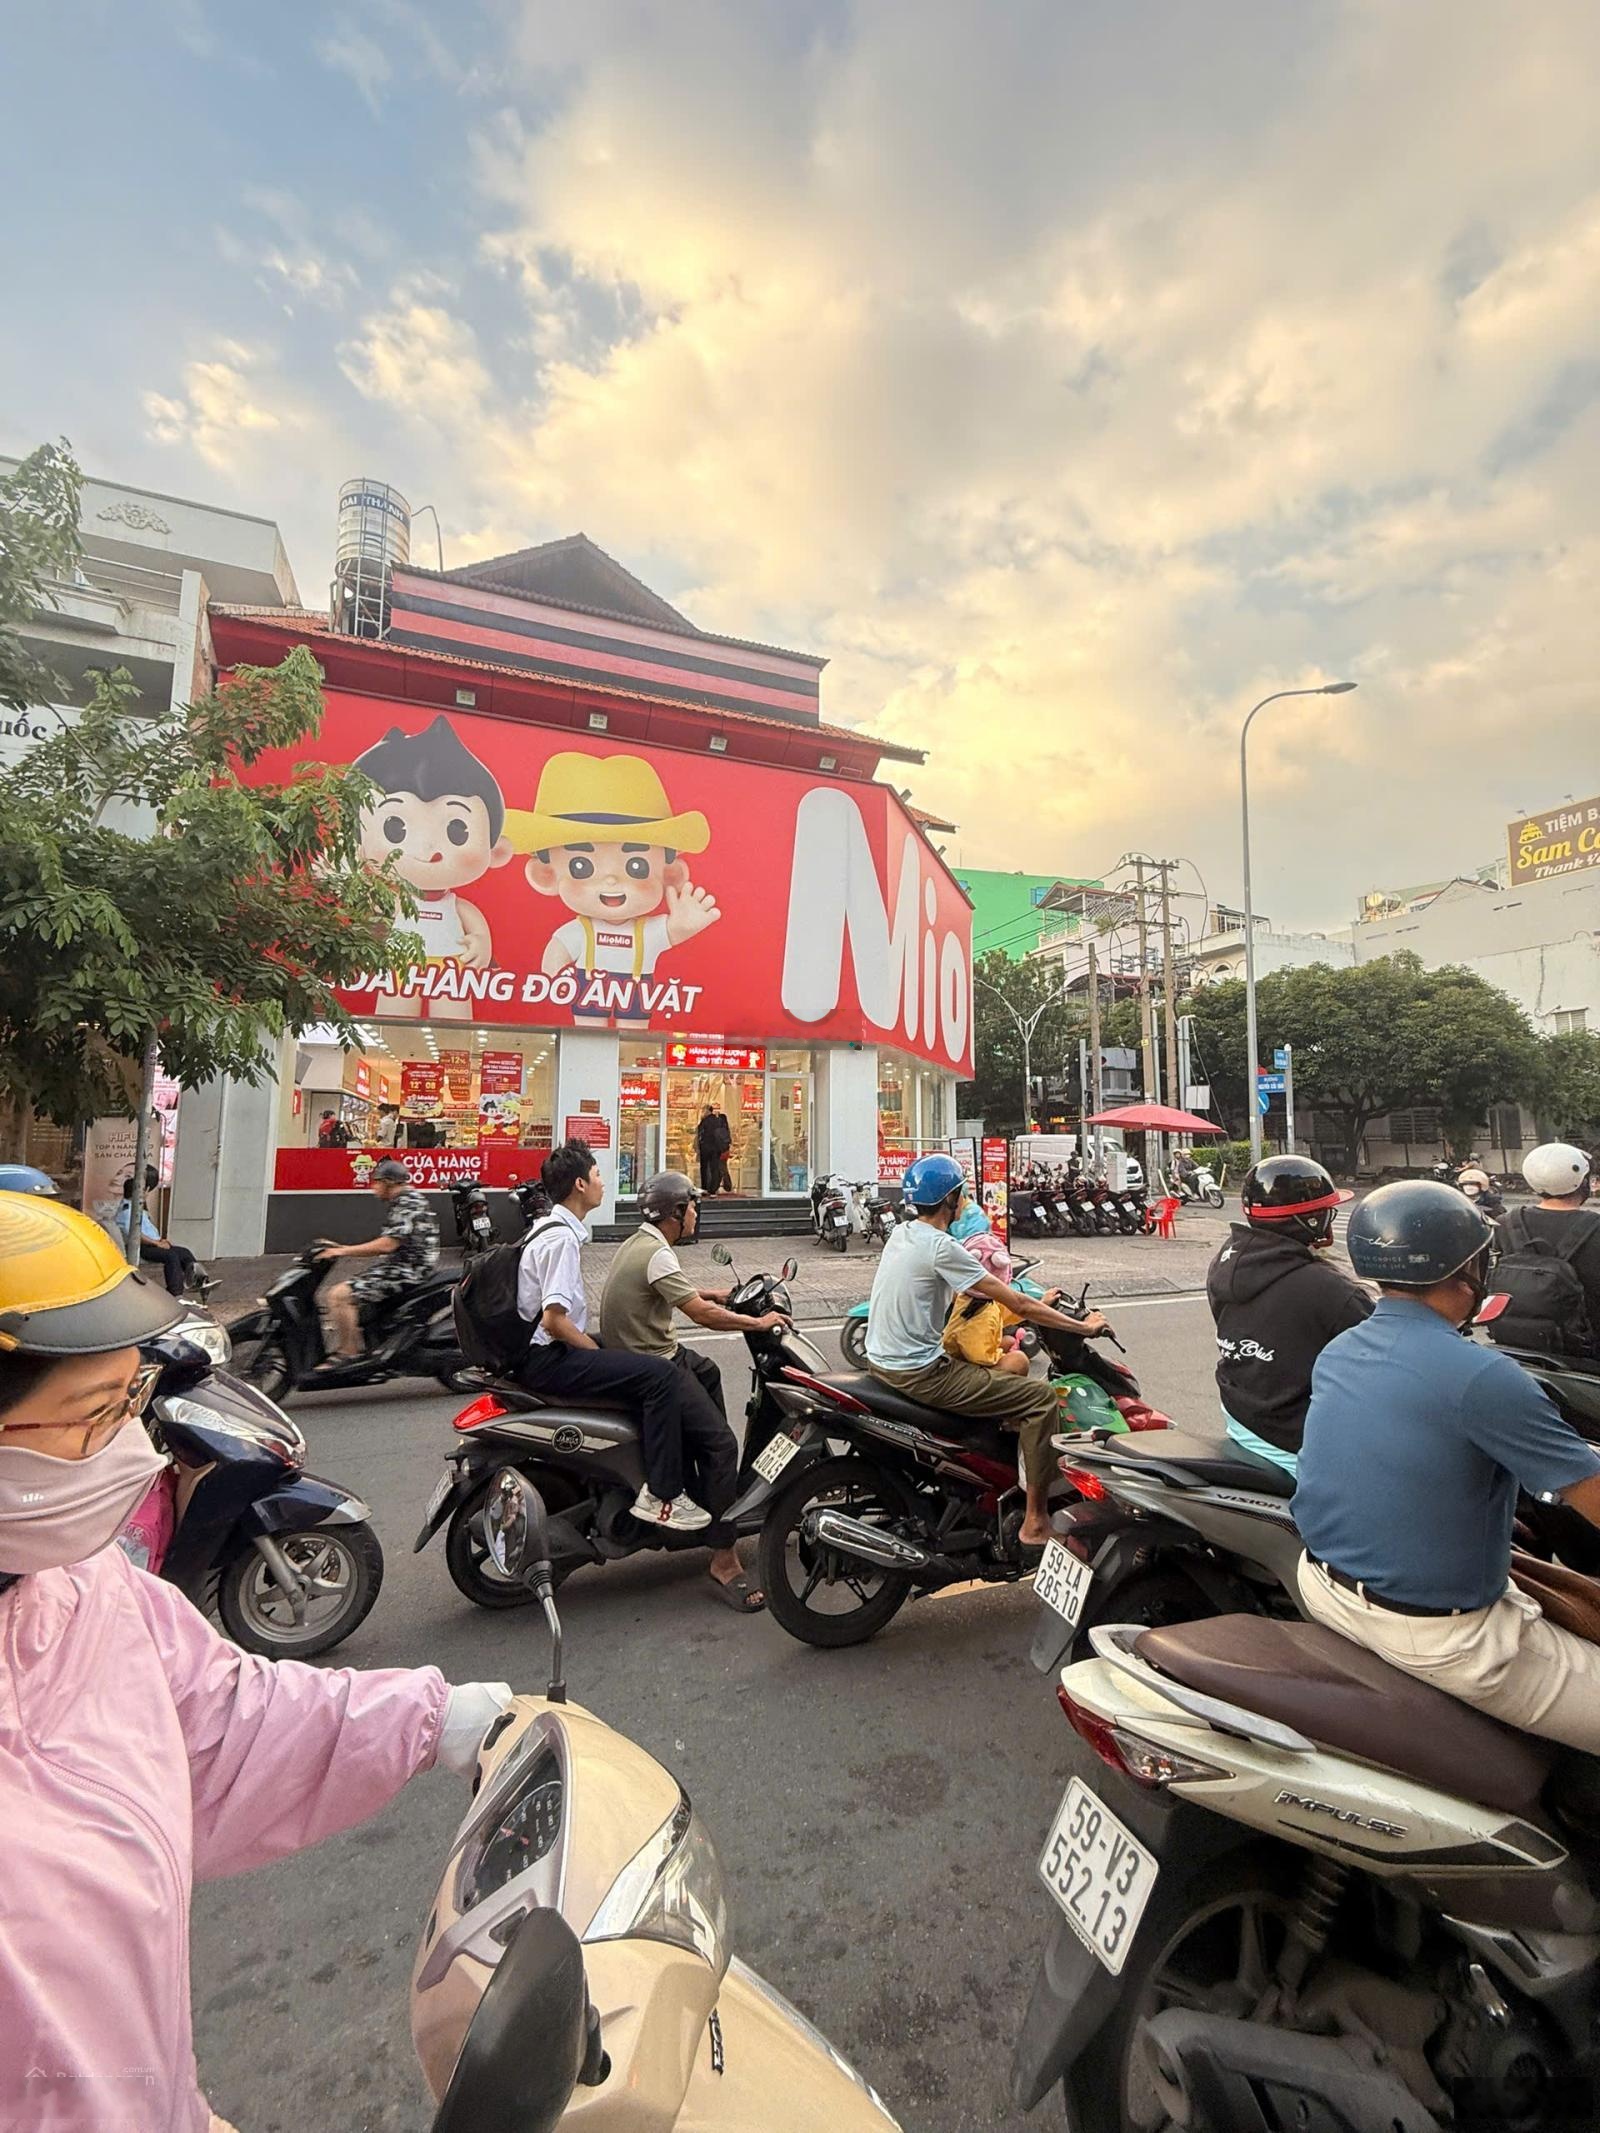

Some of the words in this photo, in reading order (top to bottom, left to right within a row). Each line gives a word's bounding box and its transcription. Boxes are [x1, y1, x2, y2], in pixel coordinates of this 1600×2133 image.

[1545, 813, 1582, 833] TIỆM
[1587, 807, 1600, 822] B
[1516, 841, 1572, 869] Sam
[1535, 857, 1584, 878] Thank
[599, 935, 631, 945] MioMio
[403, 959, 515, 1001] HÀNG
[522, 967, 577, 1003] ĐỒ
[582, 973, 632, 1009] ĂN
[641, 978, 702, 1019] VẶT
[403, 1152, 434, 1169] CỬA
[438, 1152, 481, 1169] HÀNG
[1047, 1546, 1083, 1592] 59-LA
[1036, 1568, 1079, 1620] 285.10
[1273, 1788, 1409, 1838] IMPULSE
[1069, 1794, 1140, 1896] 59-V3
[1045, 1833, 1127, 1955] 552.13
